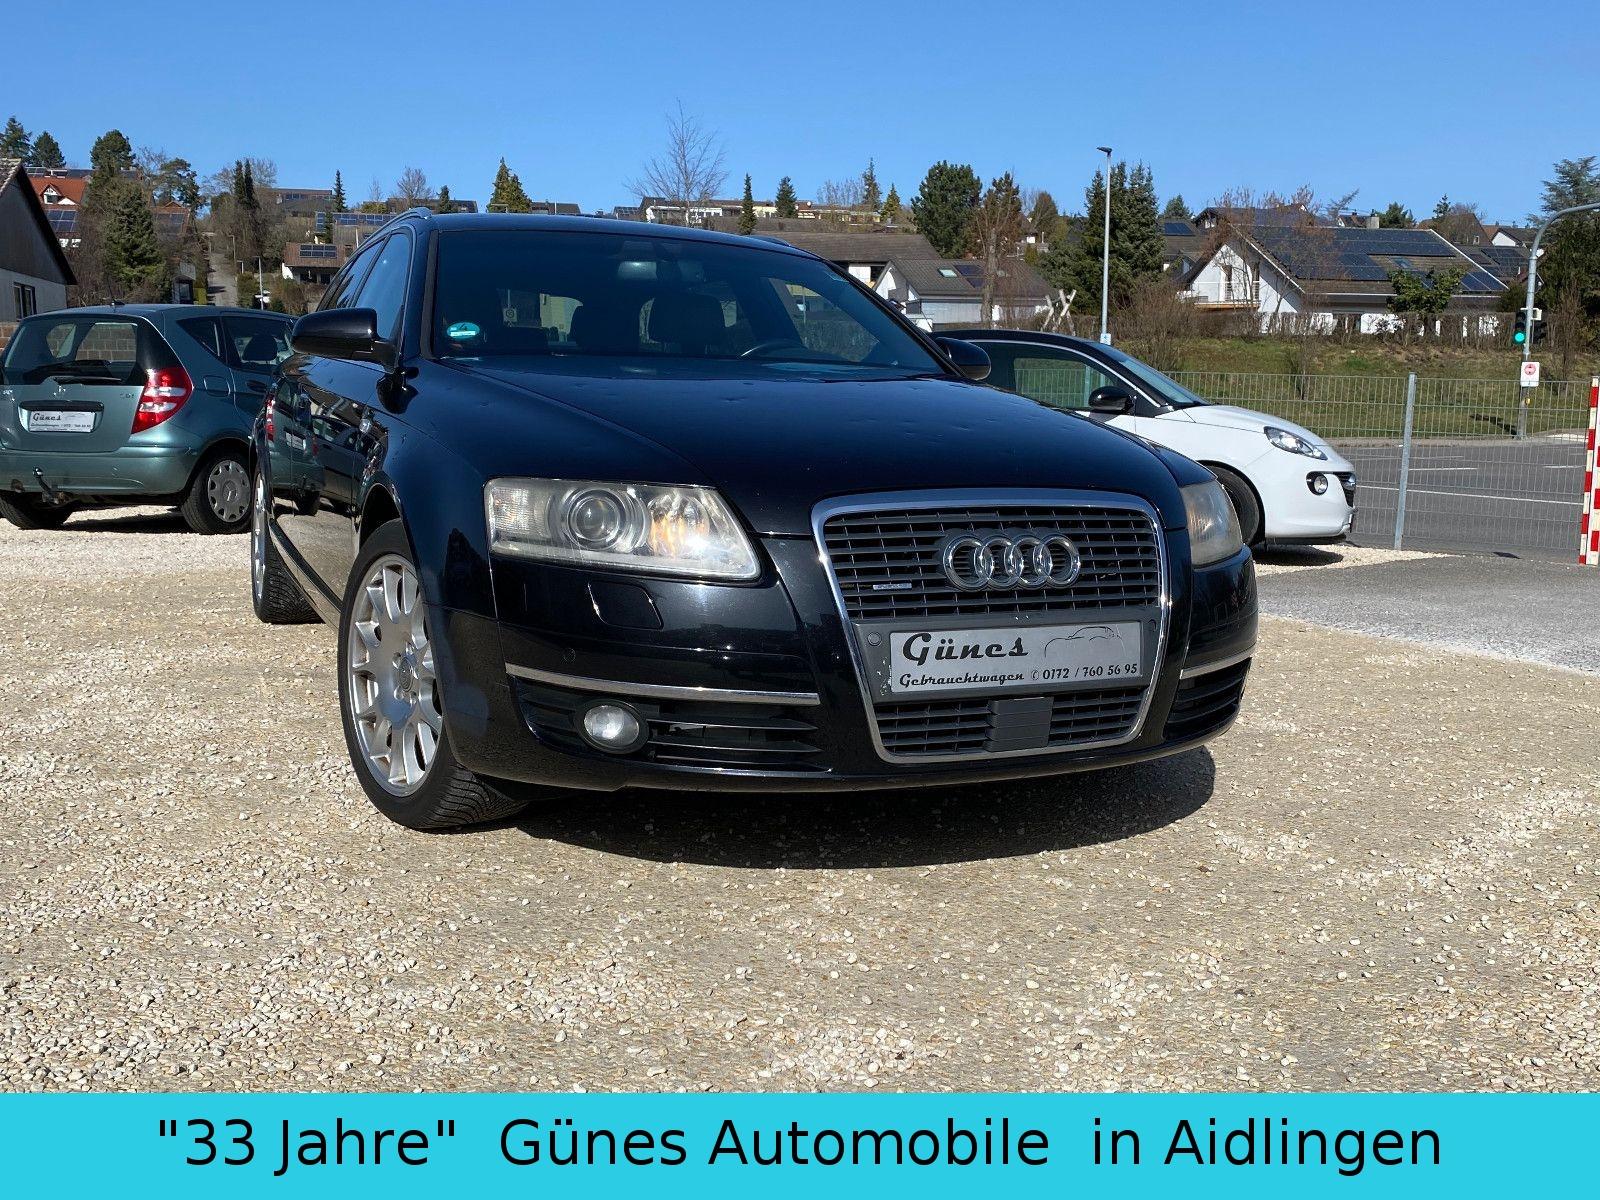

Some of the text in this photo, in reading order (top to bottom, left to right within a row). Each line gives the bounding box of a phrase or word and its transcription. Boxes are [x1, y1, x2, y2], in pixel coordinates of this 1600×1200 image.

[902, 632, 1029, 666] Günes
[899, 672, 1025, 688] Gebrauchtwagen
[1042, 668, 1070, 680] 0172
[1082, 665, 1104, 677] 760
[1107, 664, 1121, 676] 56
[1124, 663, 1138, 674] 95
